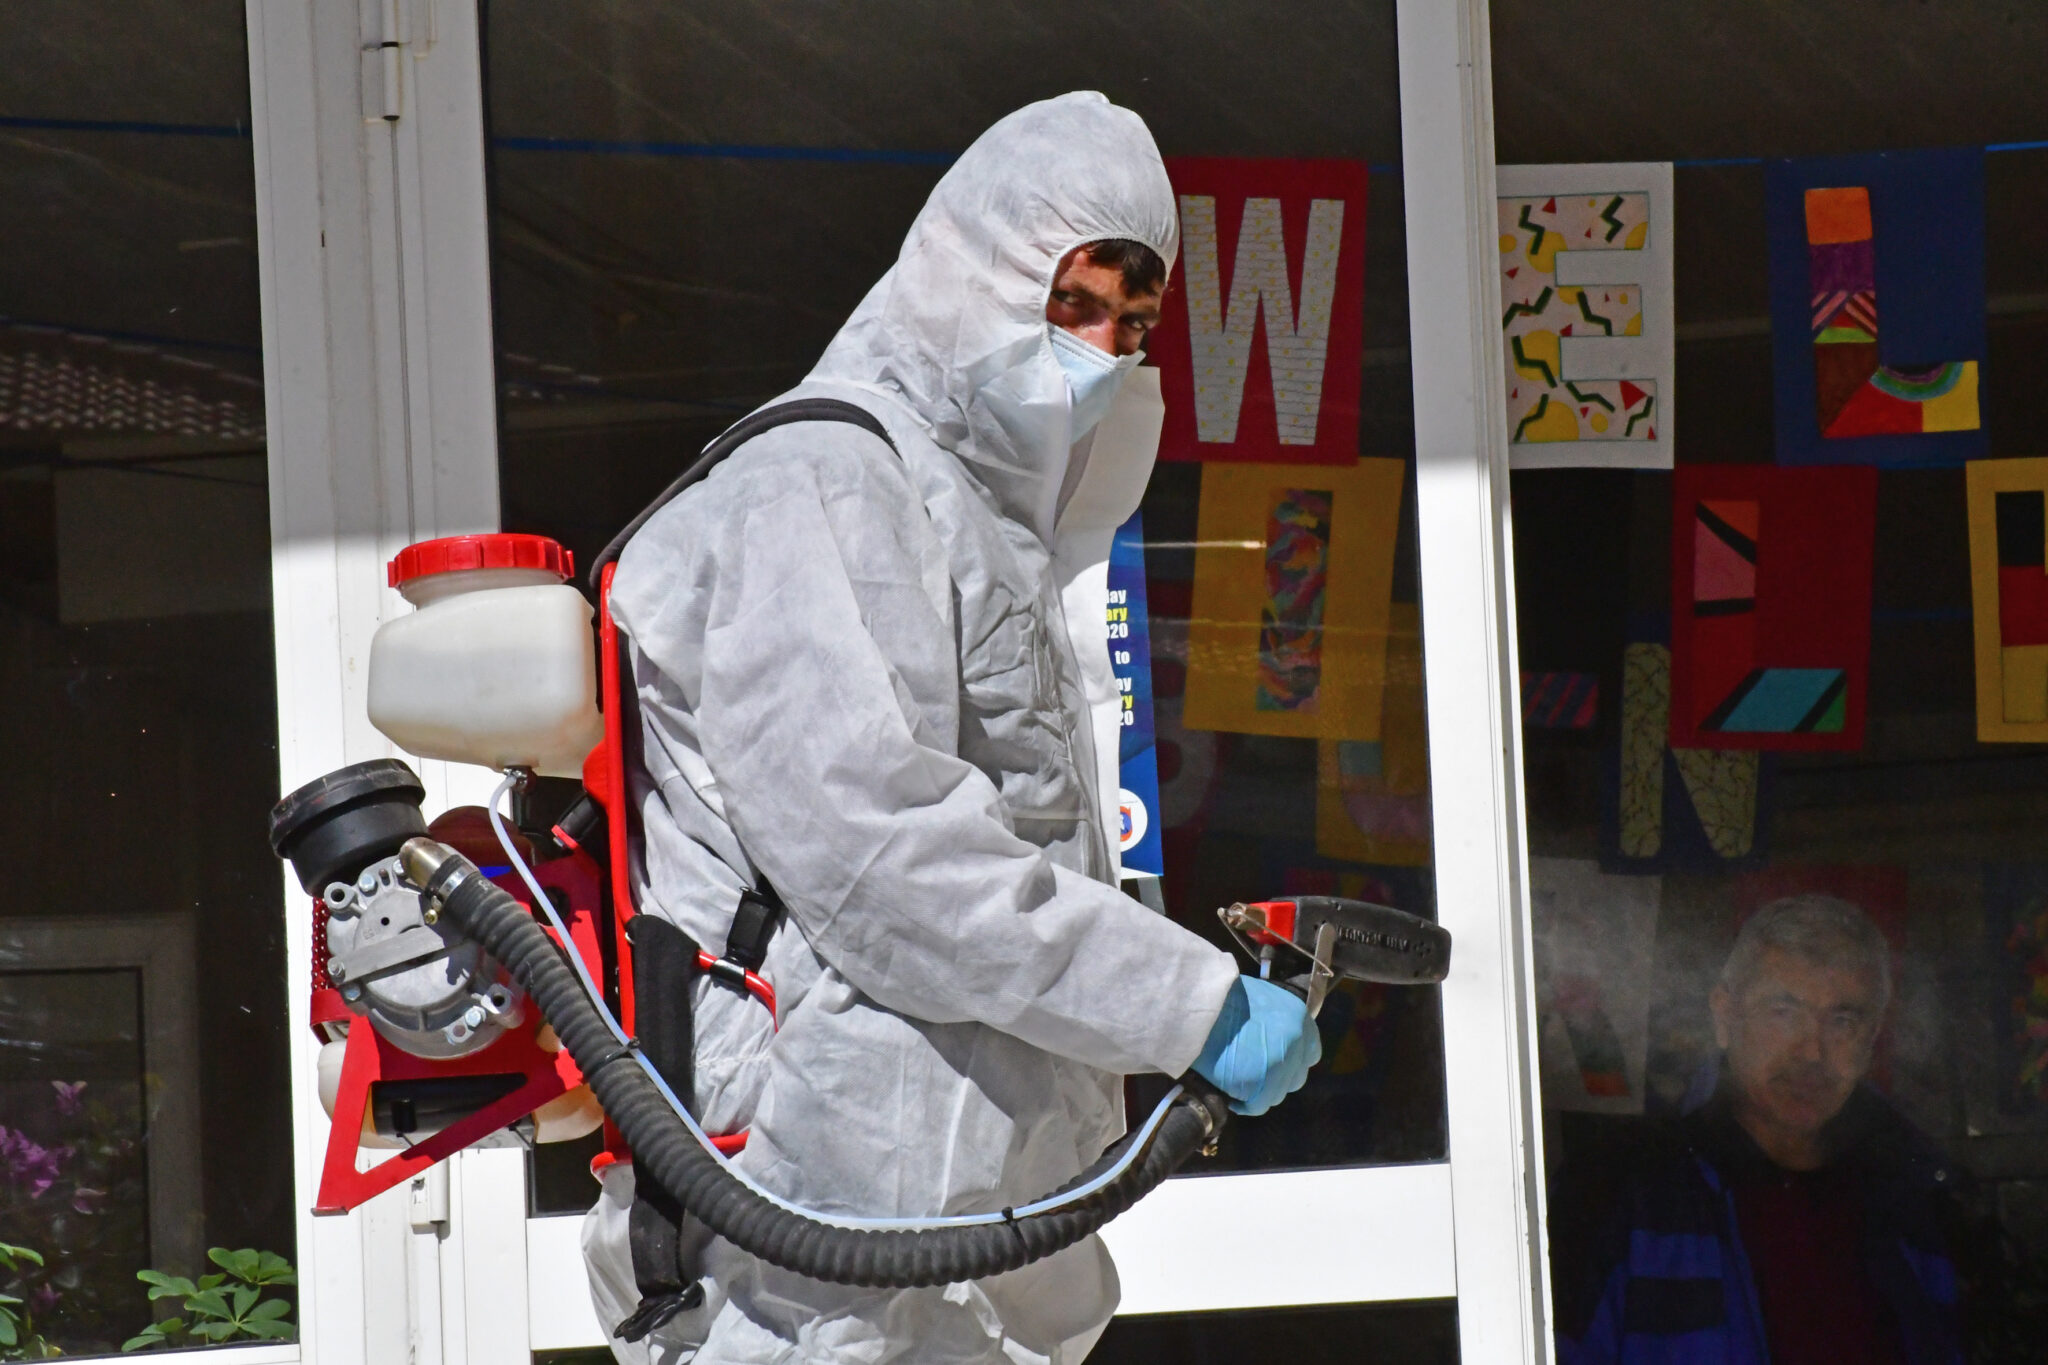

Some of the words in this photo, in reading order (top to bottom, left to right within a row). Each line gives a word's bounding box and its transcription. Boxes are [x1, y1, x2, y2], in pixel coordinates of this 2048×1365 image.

[1180, 195, 1344, 445] W
[1497, 191, 1657, 444] E
[1804, 186, 1981, 438] L
[1115, 650, 1130, 664] to
